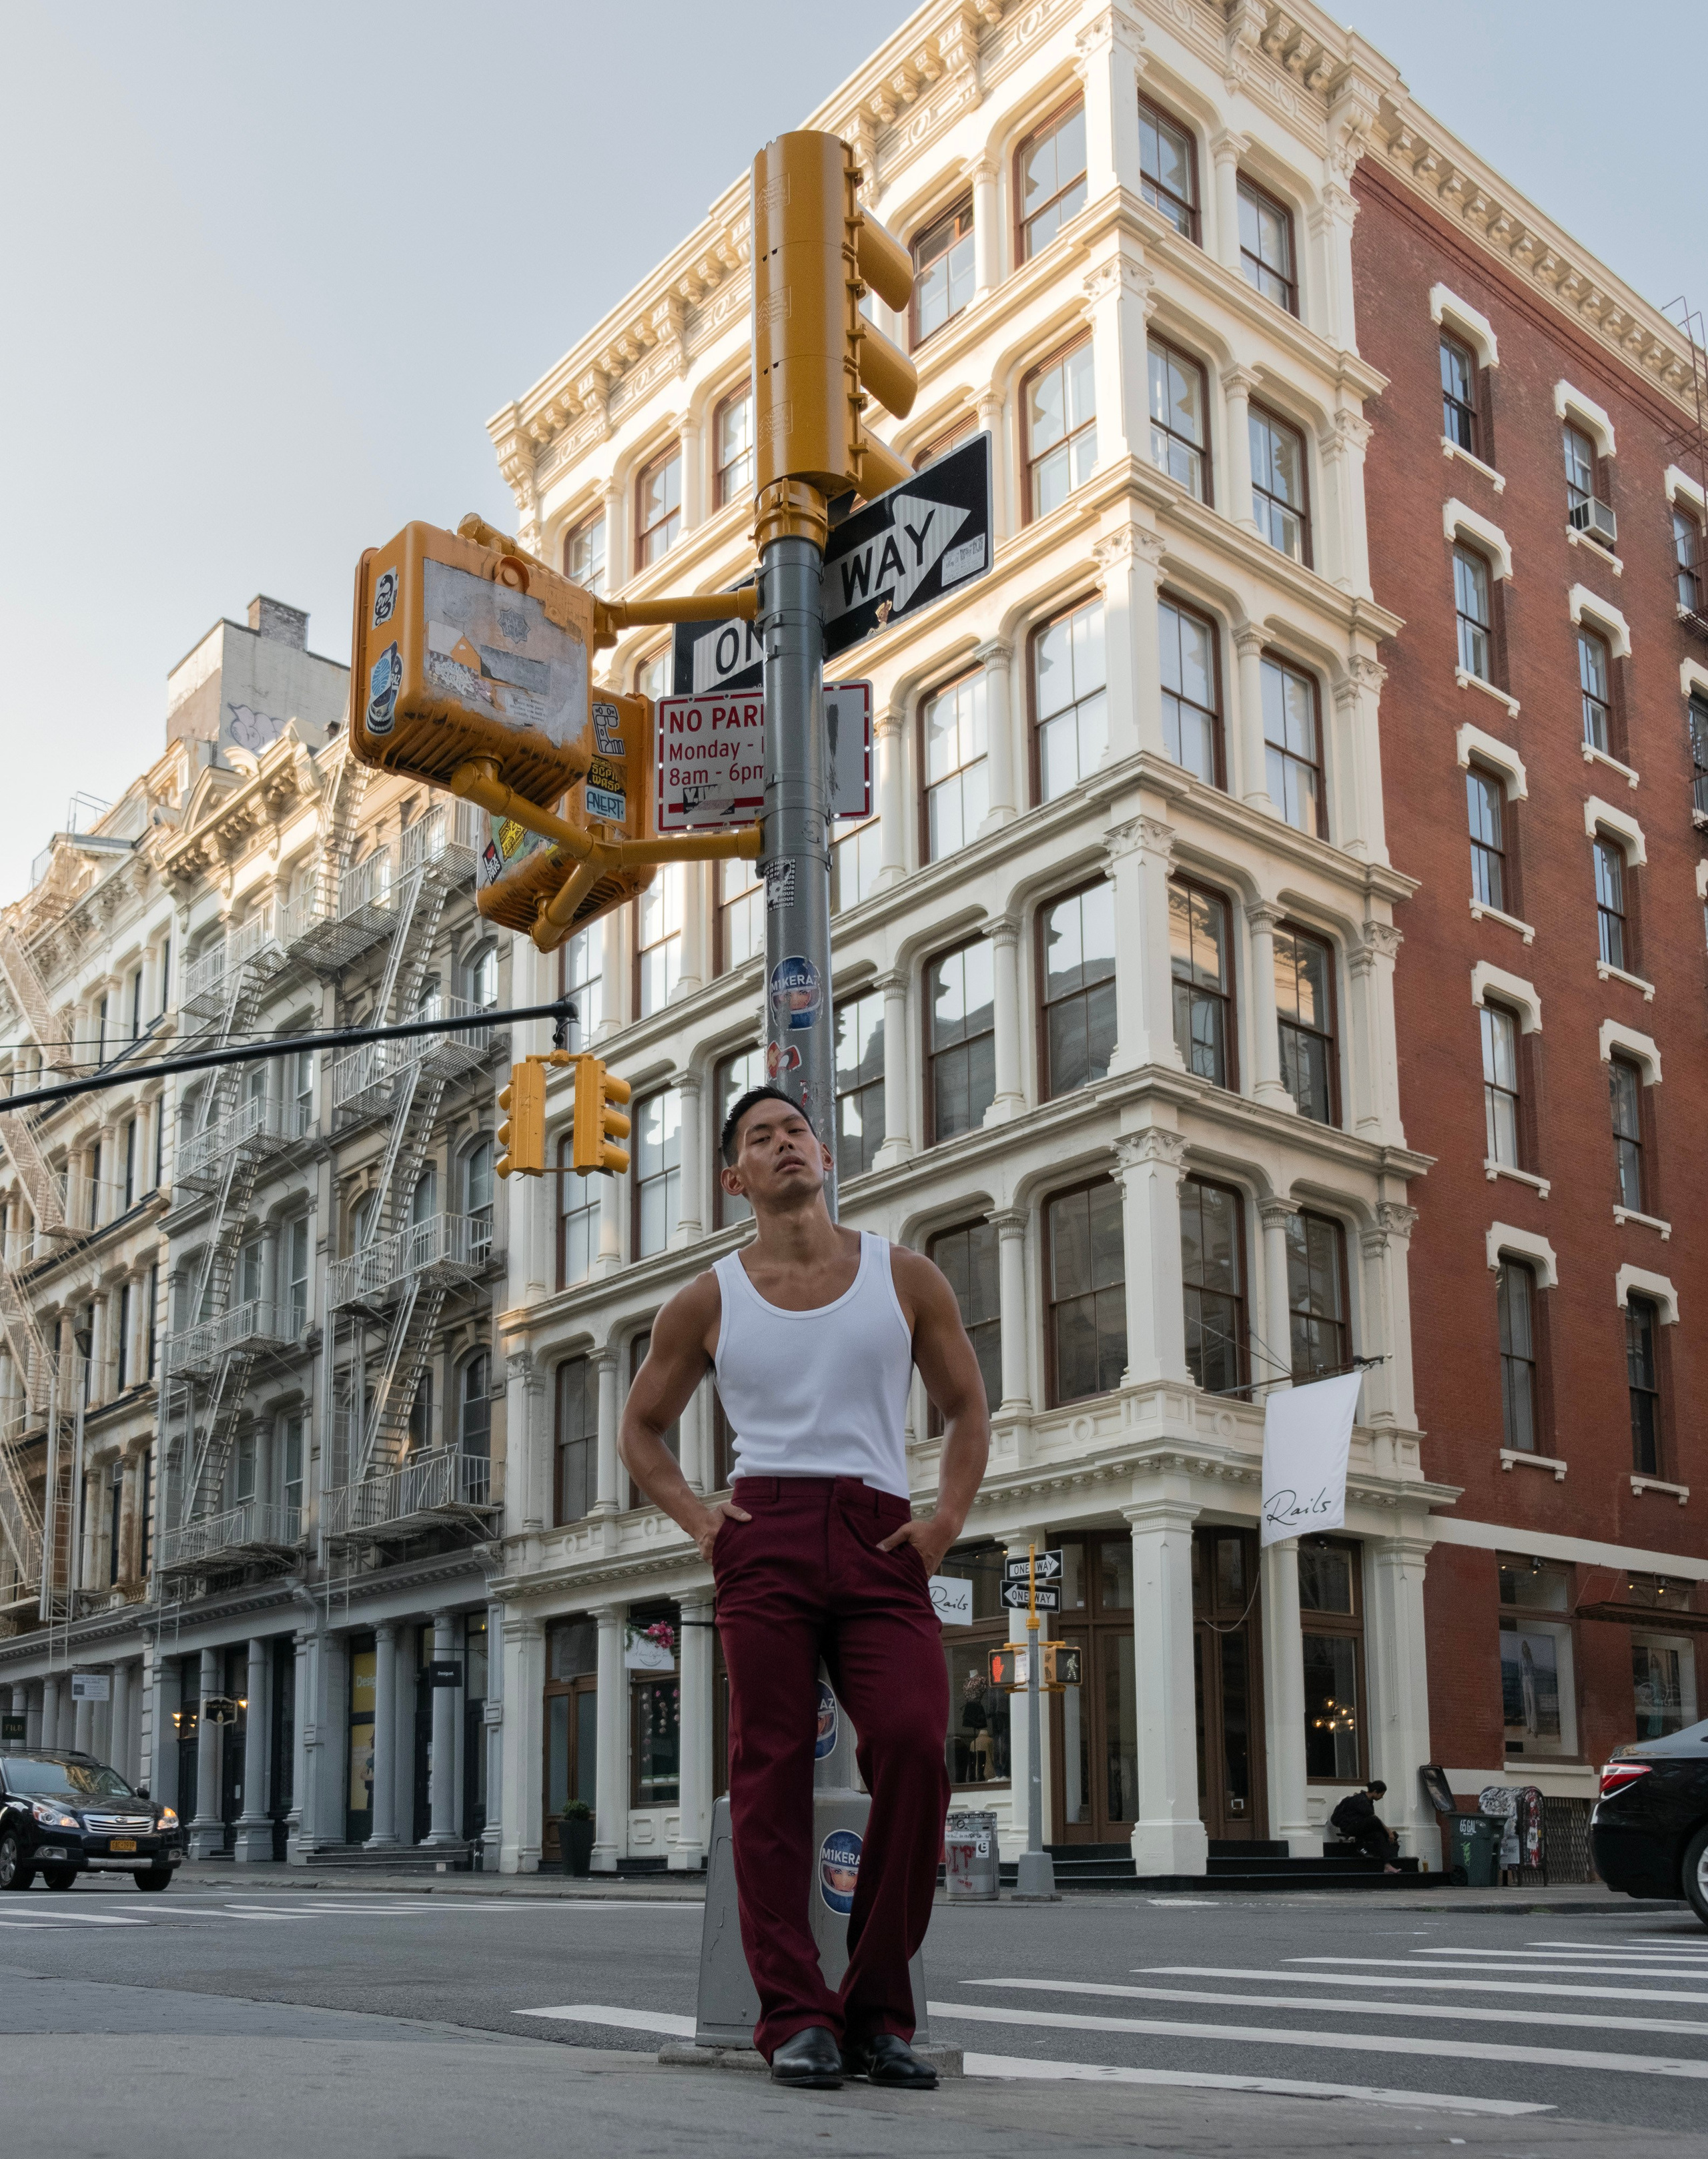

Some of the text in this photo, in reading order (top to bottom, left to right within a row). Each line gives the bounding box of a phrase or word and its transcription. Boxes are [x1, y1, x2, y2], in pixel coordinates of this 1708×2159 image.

[841, 508, 936, 607] WAY
[670, 709, 703, 734] NO
[669, 739, 741, 761] Monday
[669, 768, 709, 787] 8am
[1264, 1487, 1331, 1527] Rails
[1014, 1561, 1053, 1575] ONE WAY
[929, 1586, 969, 1613] Rails
[1011, 1591, 1051, 1604] ONE WAY
[817, 1697, 835, 1711] AZ
[1460, 1819, 1476, 1833] 65 GAL
